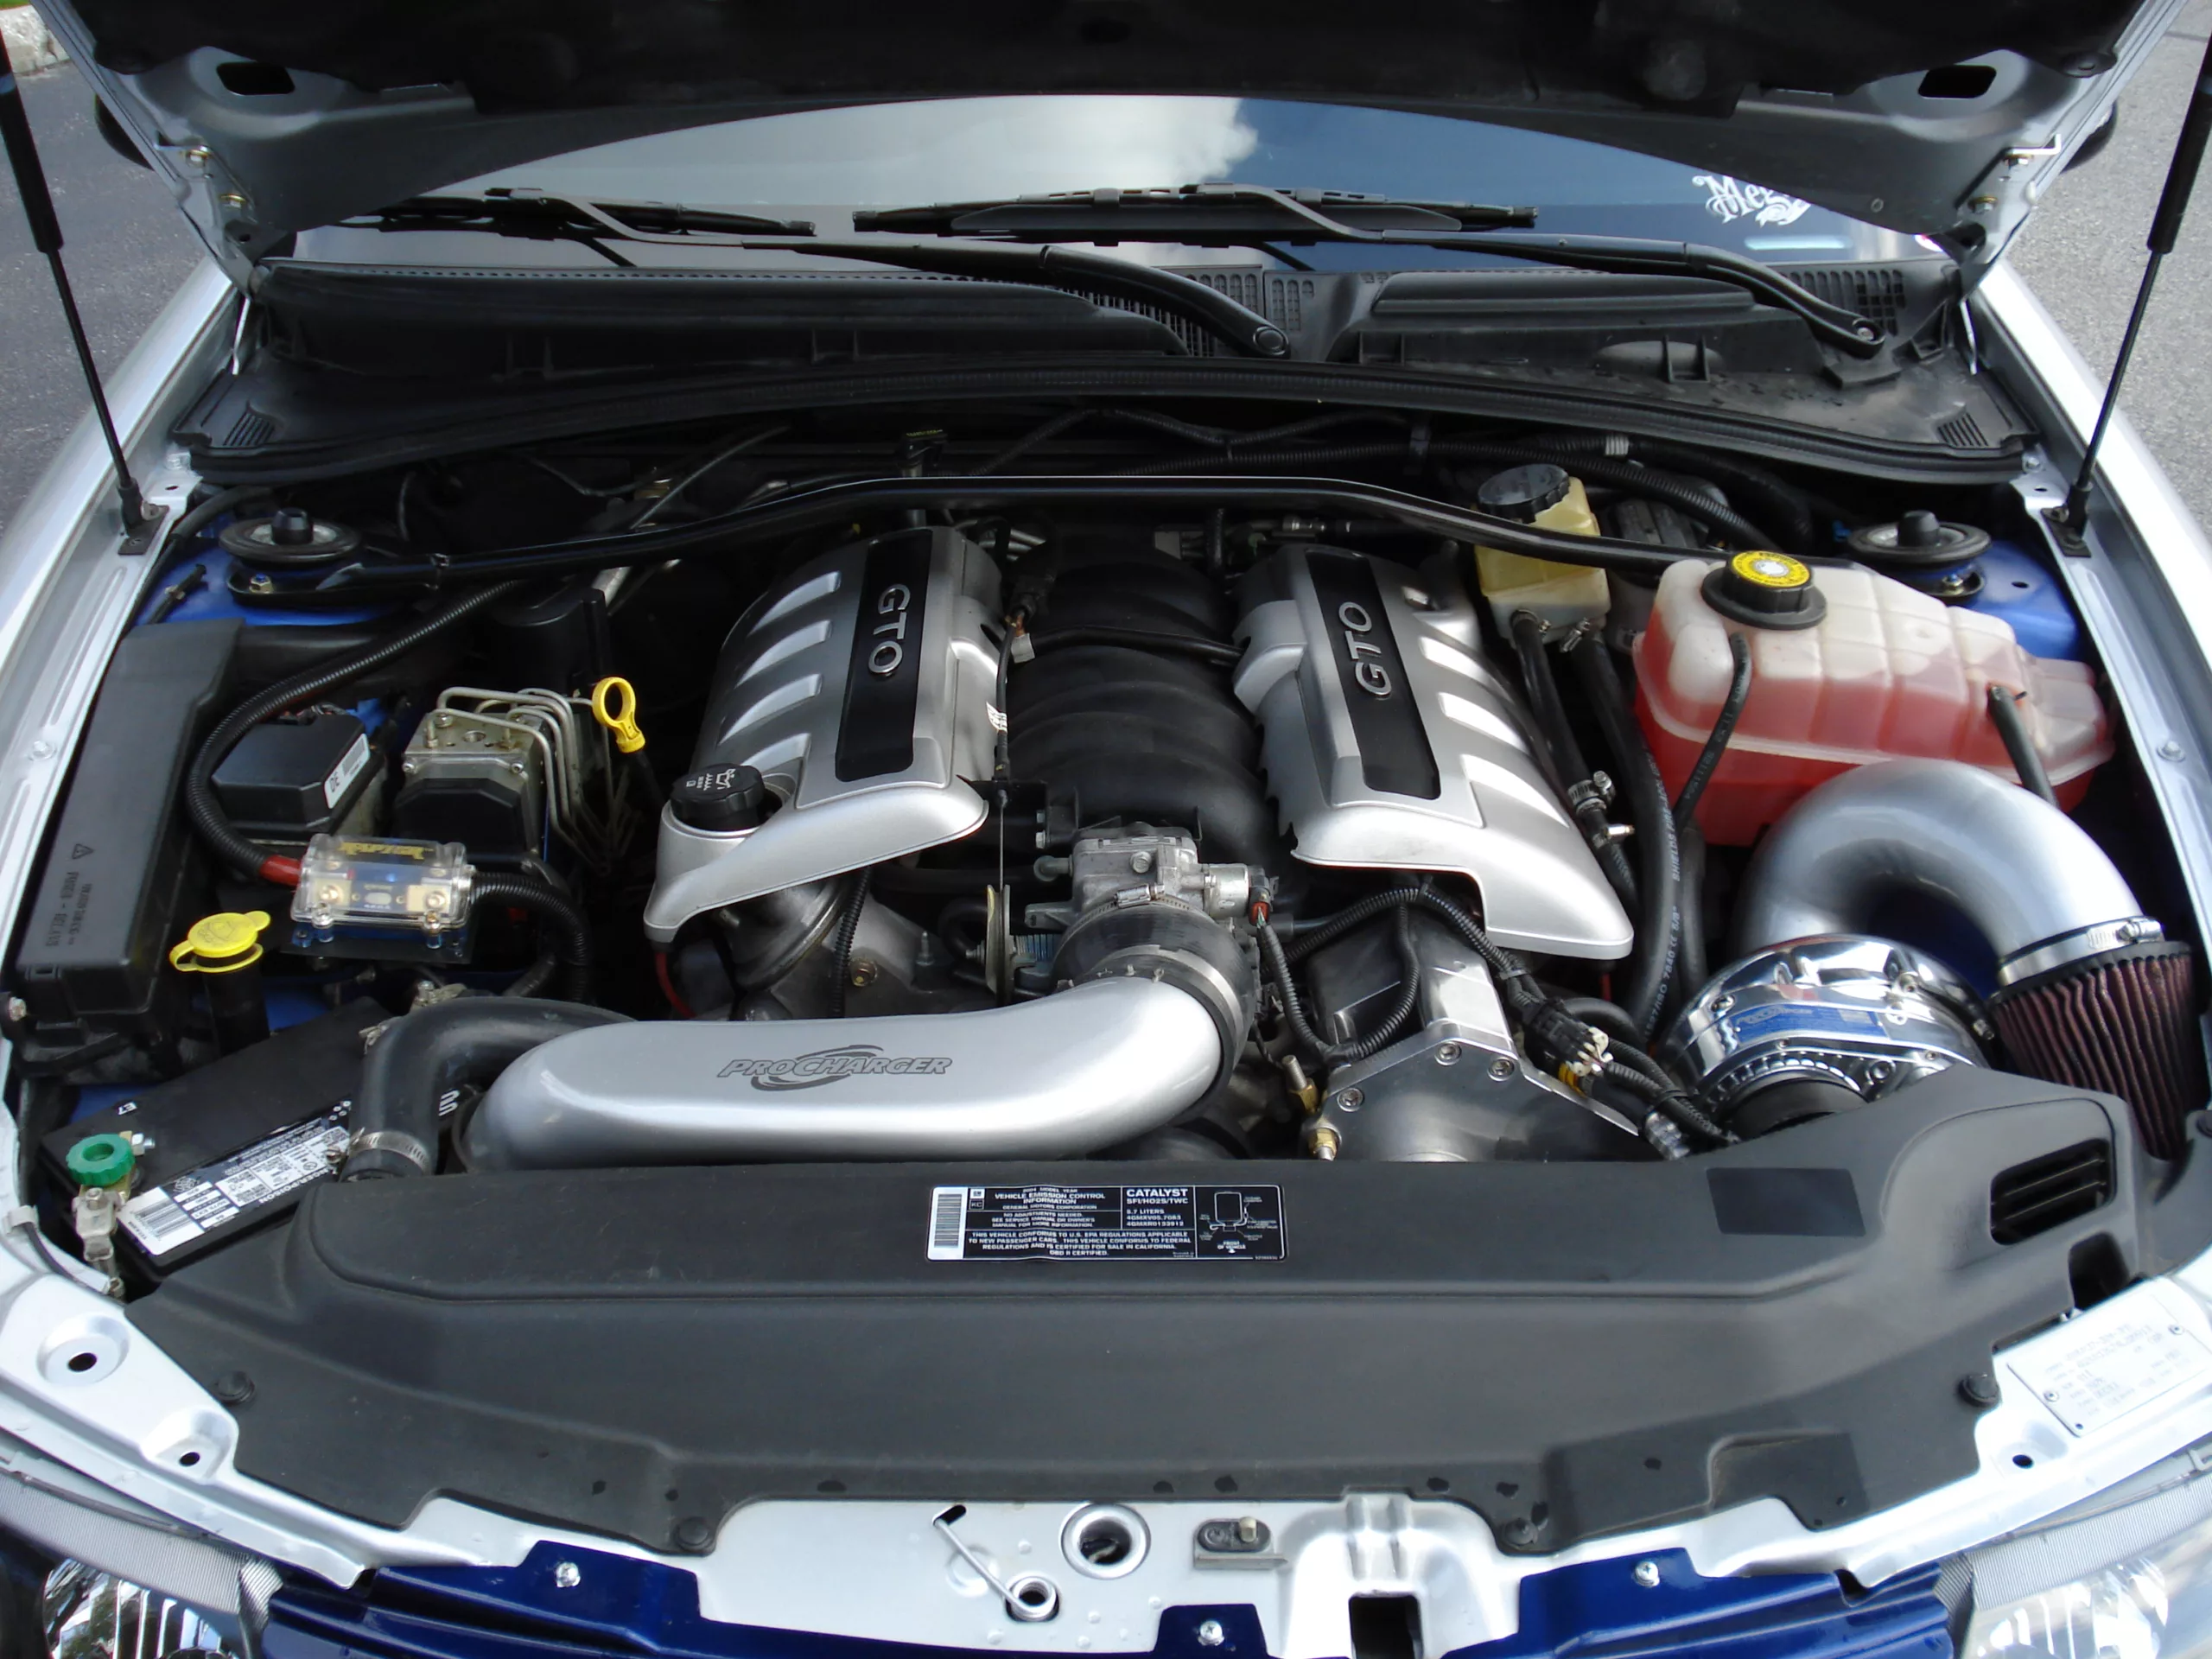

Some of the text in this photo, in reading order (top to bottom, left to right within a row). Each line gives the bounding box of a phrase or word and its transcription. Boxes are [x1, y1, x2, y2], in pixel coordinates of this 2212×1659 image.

[868, 583, 911, 674] GTO
[1338, 601, 1392, 696] GTO
[716, 1057, 952, 1077] PROCHARGER
[259, 1166, 338, 1205] NGER/POISON
[1126, 1188, 1188, 1197] CATALYST
